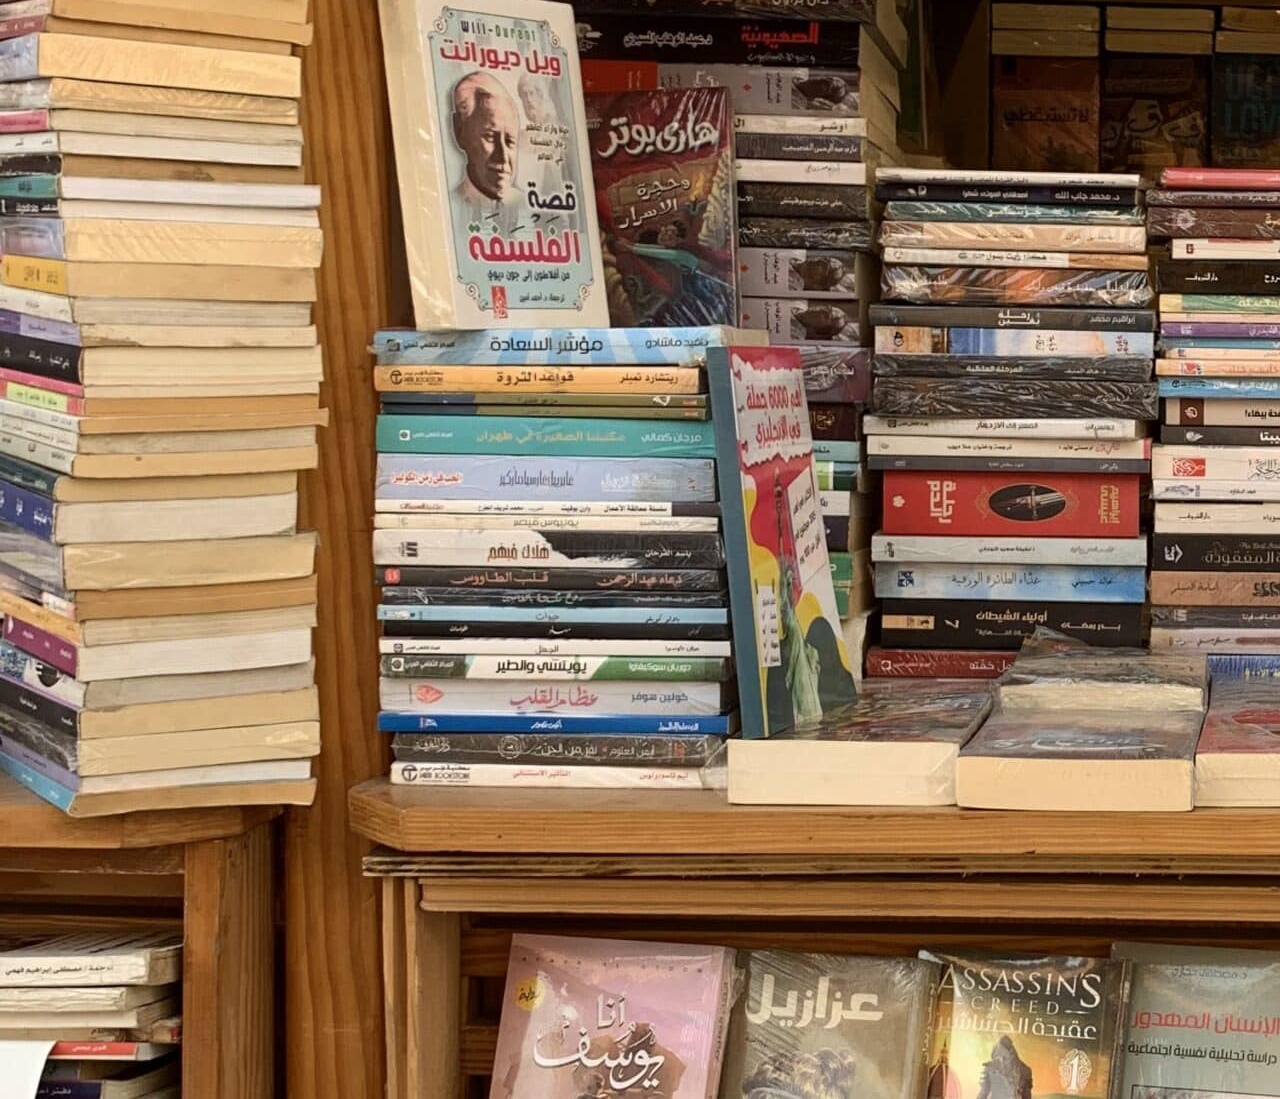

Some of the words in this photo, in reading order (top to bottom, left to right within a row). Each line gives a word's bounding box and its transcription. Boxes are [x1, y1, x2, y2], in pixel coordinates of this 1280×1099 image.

[439, 38, 521, 72] ديورانت
[525, 52, 562, 78] ويل
[527, 180, 576, 212] قصة
[489, 336, 553, 353] السعادة
[936, 962, 1102, 1009] ASSASSIN'S
[744, 972, 884, 1029] عزازيل
[970, 995, 1060, 1016] CREED
[1130, 1008, 1211, 1034] المهدور
